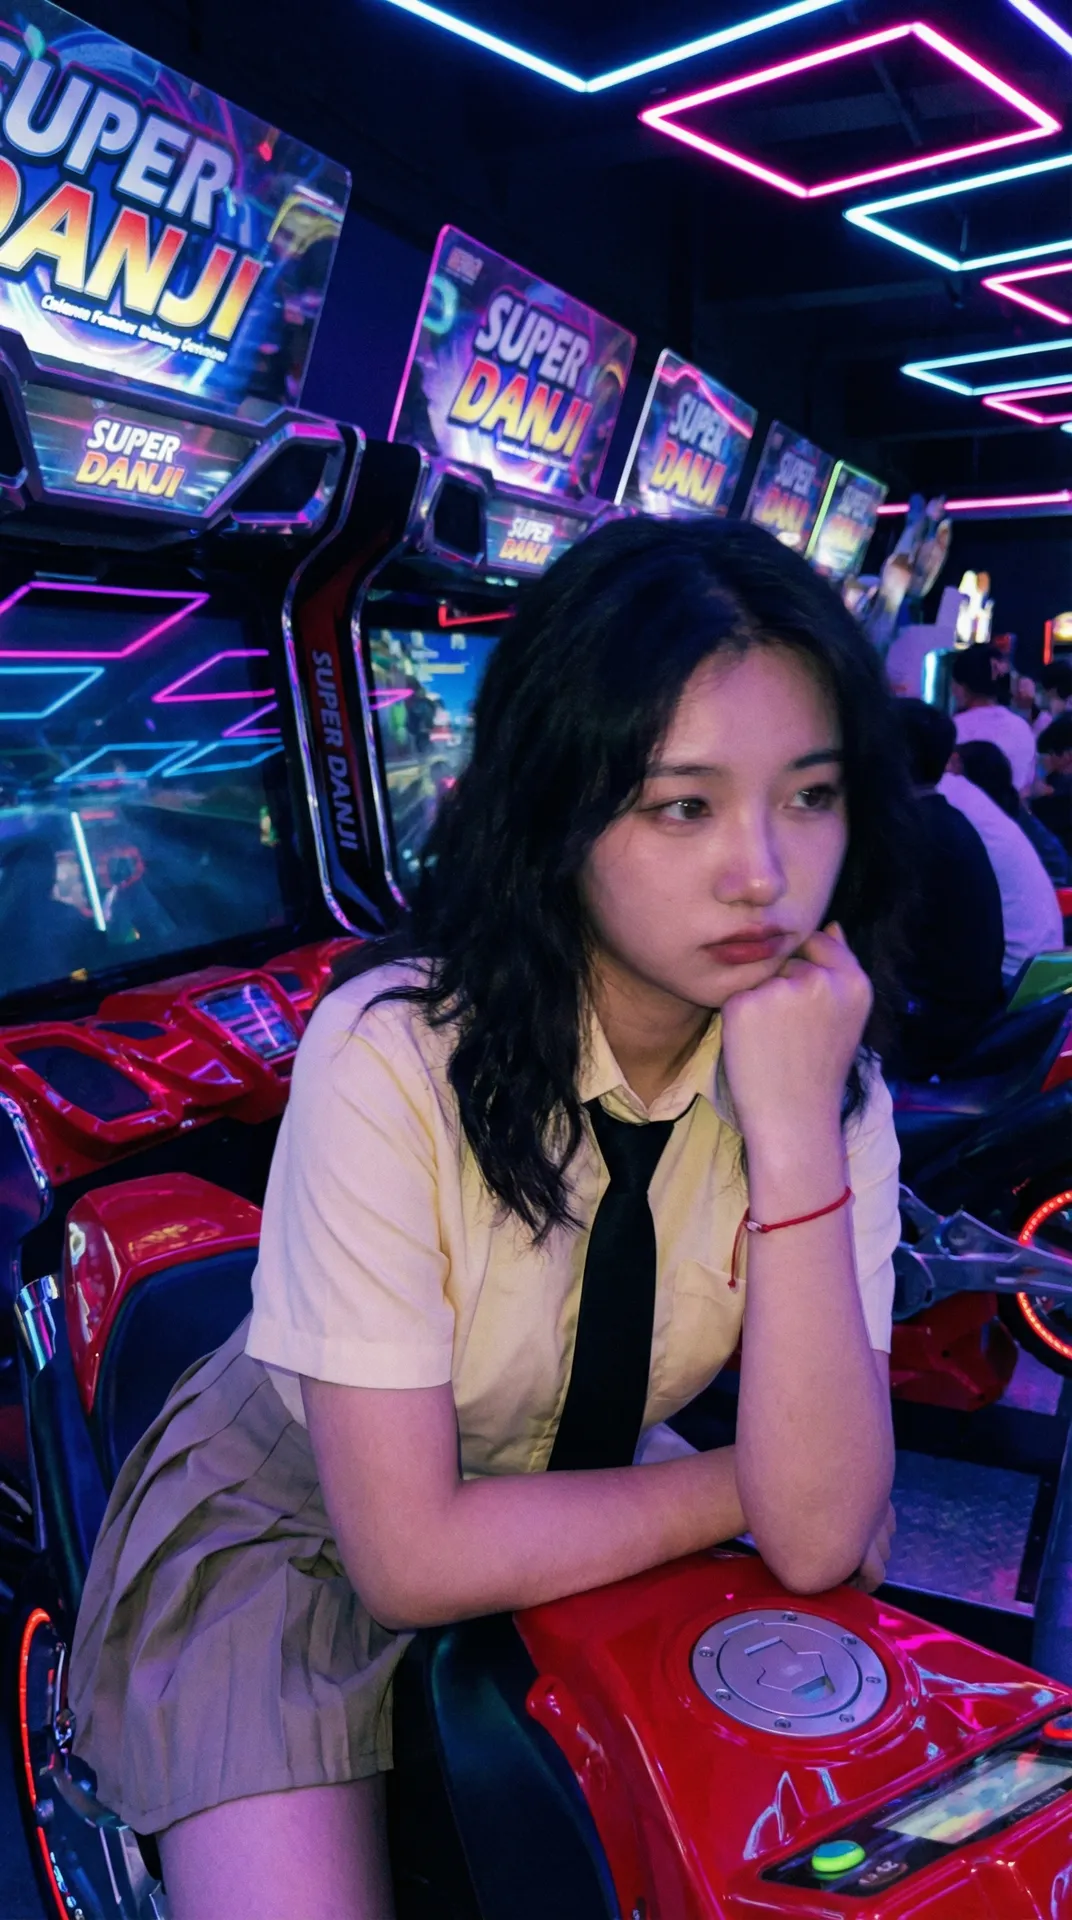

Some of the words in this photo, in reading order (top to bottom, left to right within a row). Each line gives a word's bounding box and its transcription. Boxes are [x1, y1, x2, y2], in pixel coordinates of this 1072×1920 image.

[475, 293, 590, 389] SUPER
[86, 419, 181, 463] SUPER
[450, 357, 593, 457] DANJI
[76, 450, 185, 498] DANJI
[312, 650, 344, 747] SUPER
[327, 754, 358, 850] DANJI
